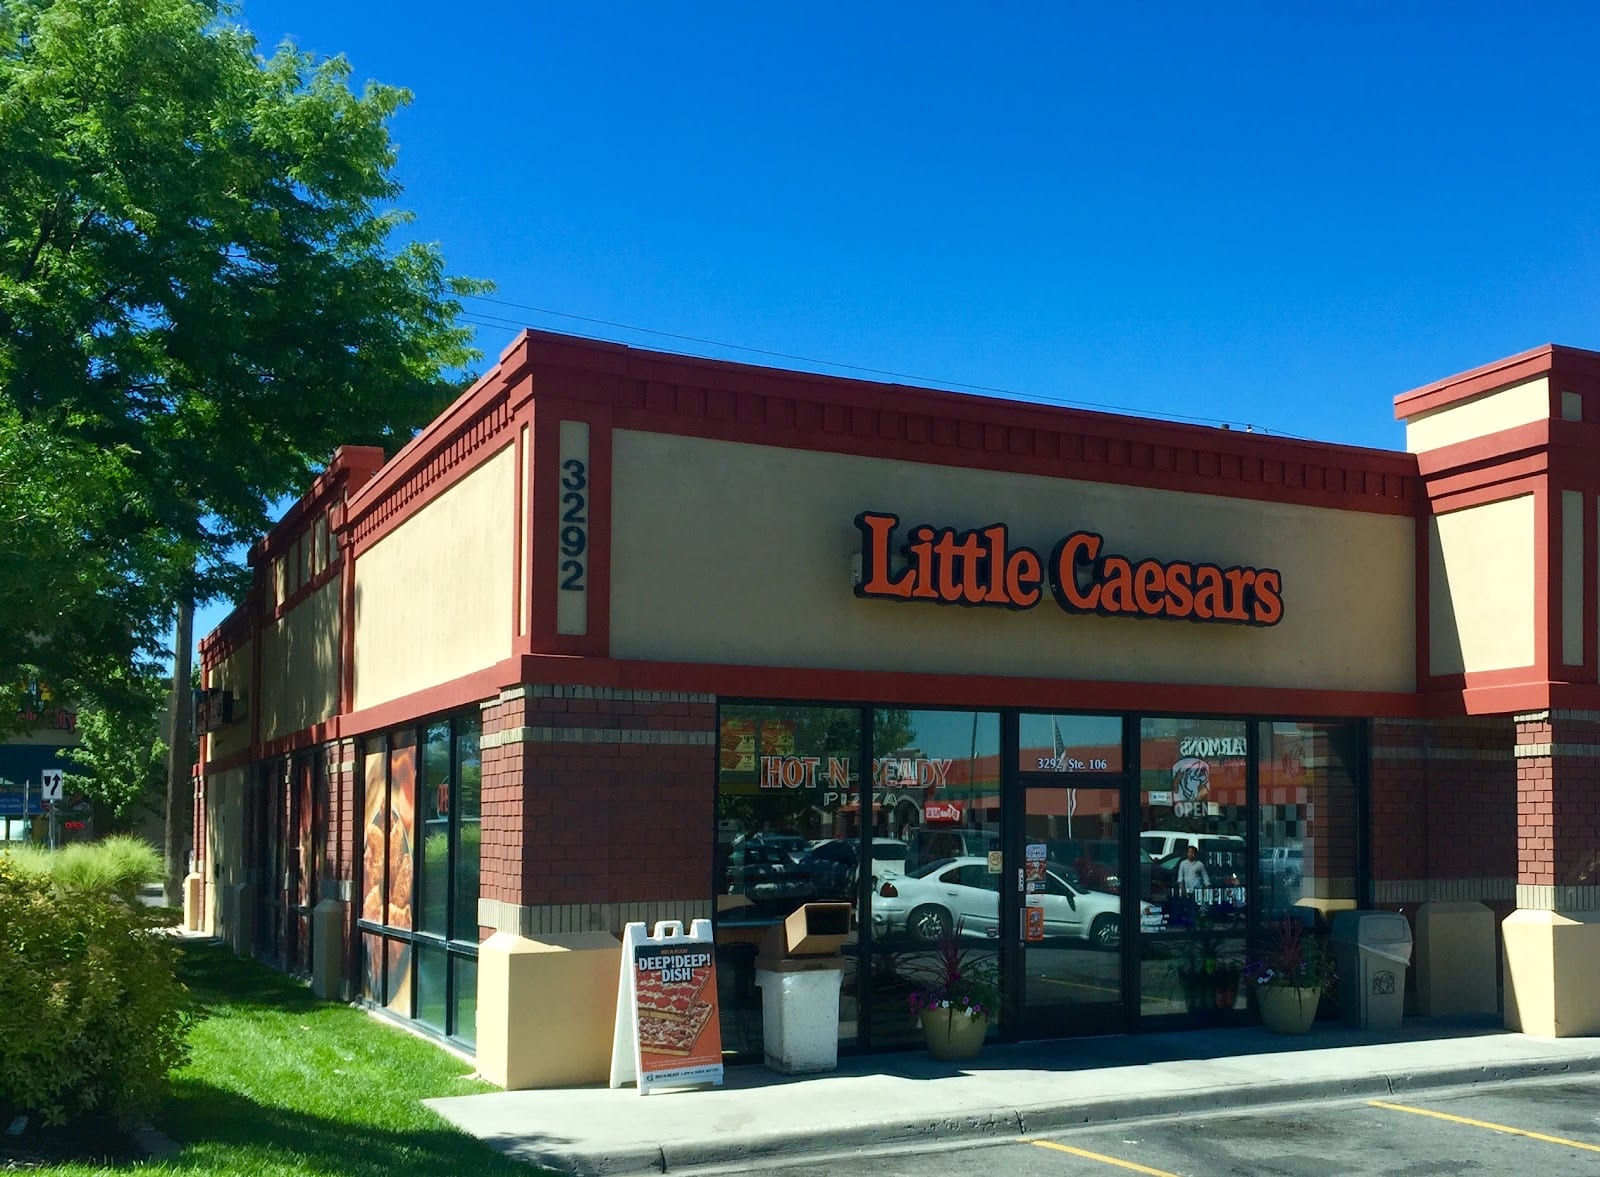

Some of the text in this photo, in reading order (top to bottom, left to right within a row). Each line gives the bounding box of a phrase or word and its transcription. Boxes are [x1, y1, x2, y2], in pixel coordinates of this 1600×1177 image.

[561, 458, 586, 592] 3292
[855, 511, 1284, 626] Little Caesars
[1037, 758, 1107, 769] 3292 Ste. 106
[1174, 801, 1209, 818] OPEN
[661, 967, 691, 982] DISH
